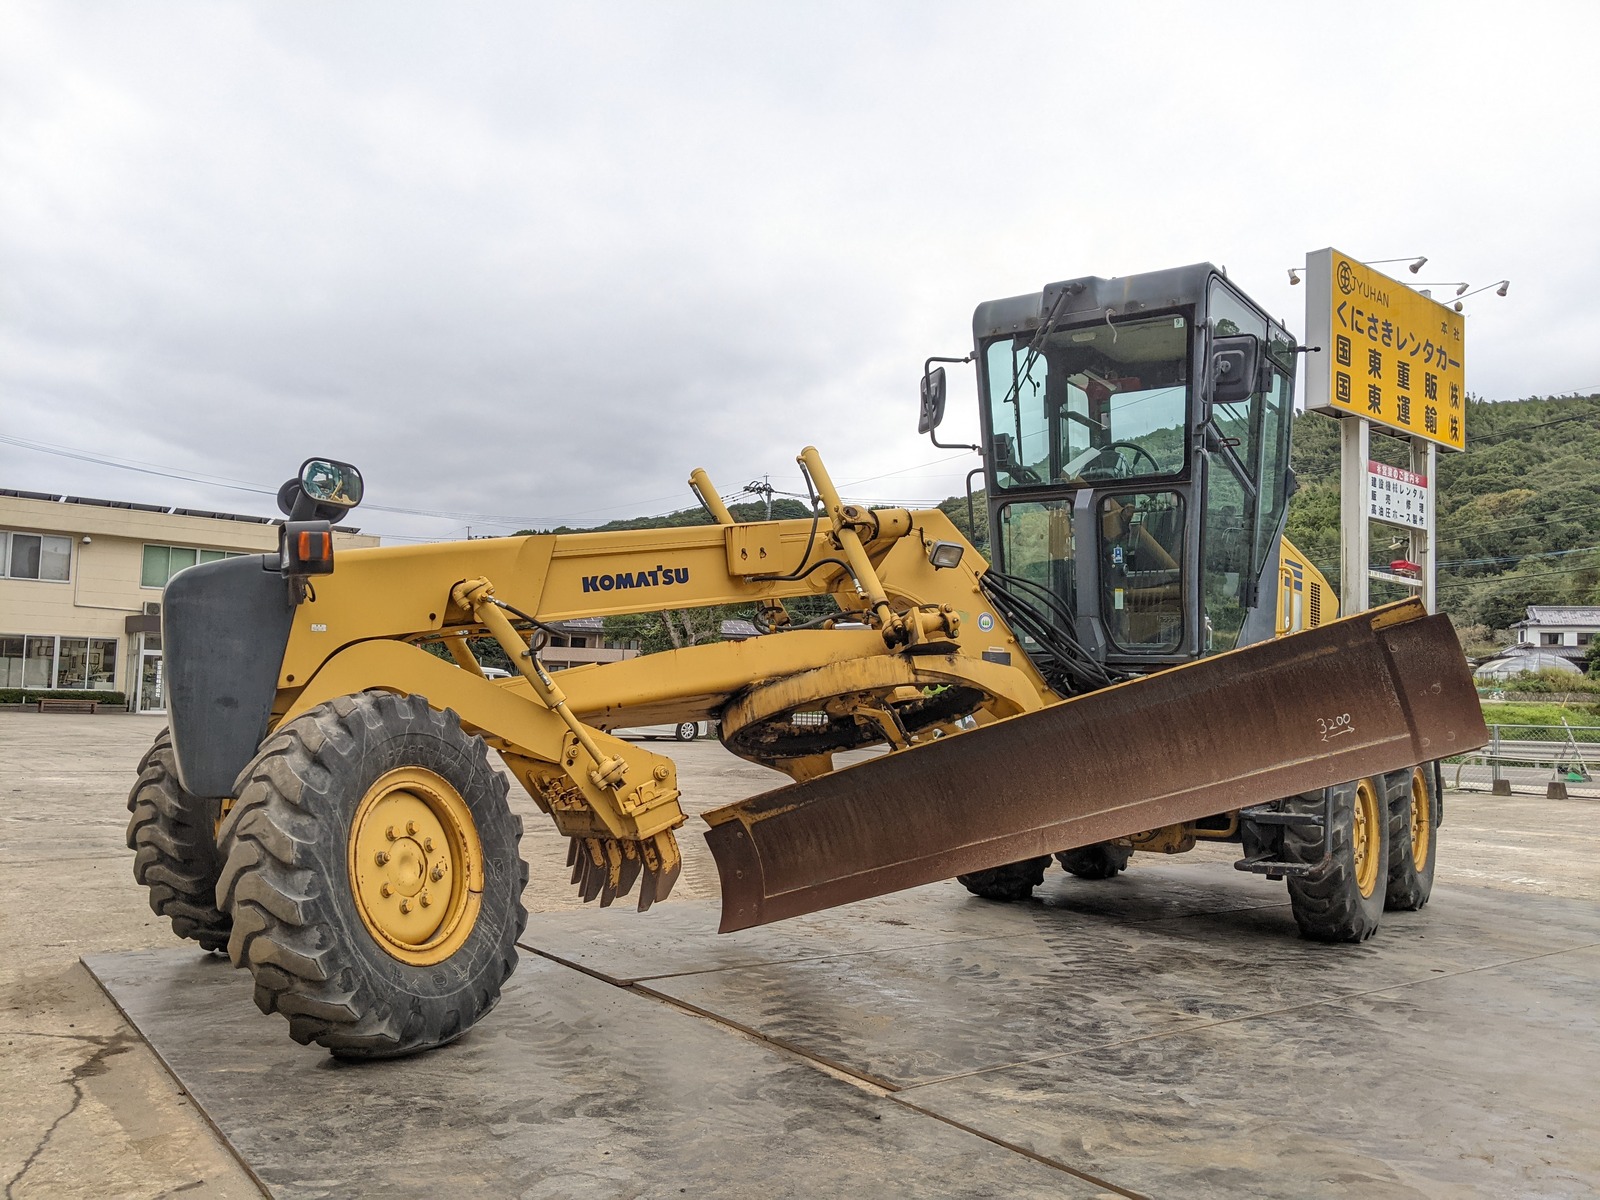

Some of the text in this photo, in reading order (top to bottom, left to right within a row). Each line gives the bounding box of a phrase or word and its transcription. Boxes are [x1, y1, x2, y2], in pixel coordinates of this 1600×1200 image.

[1350, 276, 1389, 308] JYUHAN
[1336, 300, 1461, 371] くにさきレンタカー
[1441, 321, 1460, 342] 本社
[582, 565, 689, 593] KOMATSU
[1317, 713, 1351, 734] 3200
